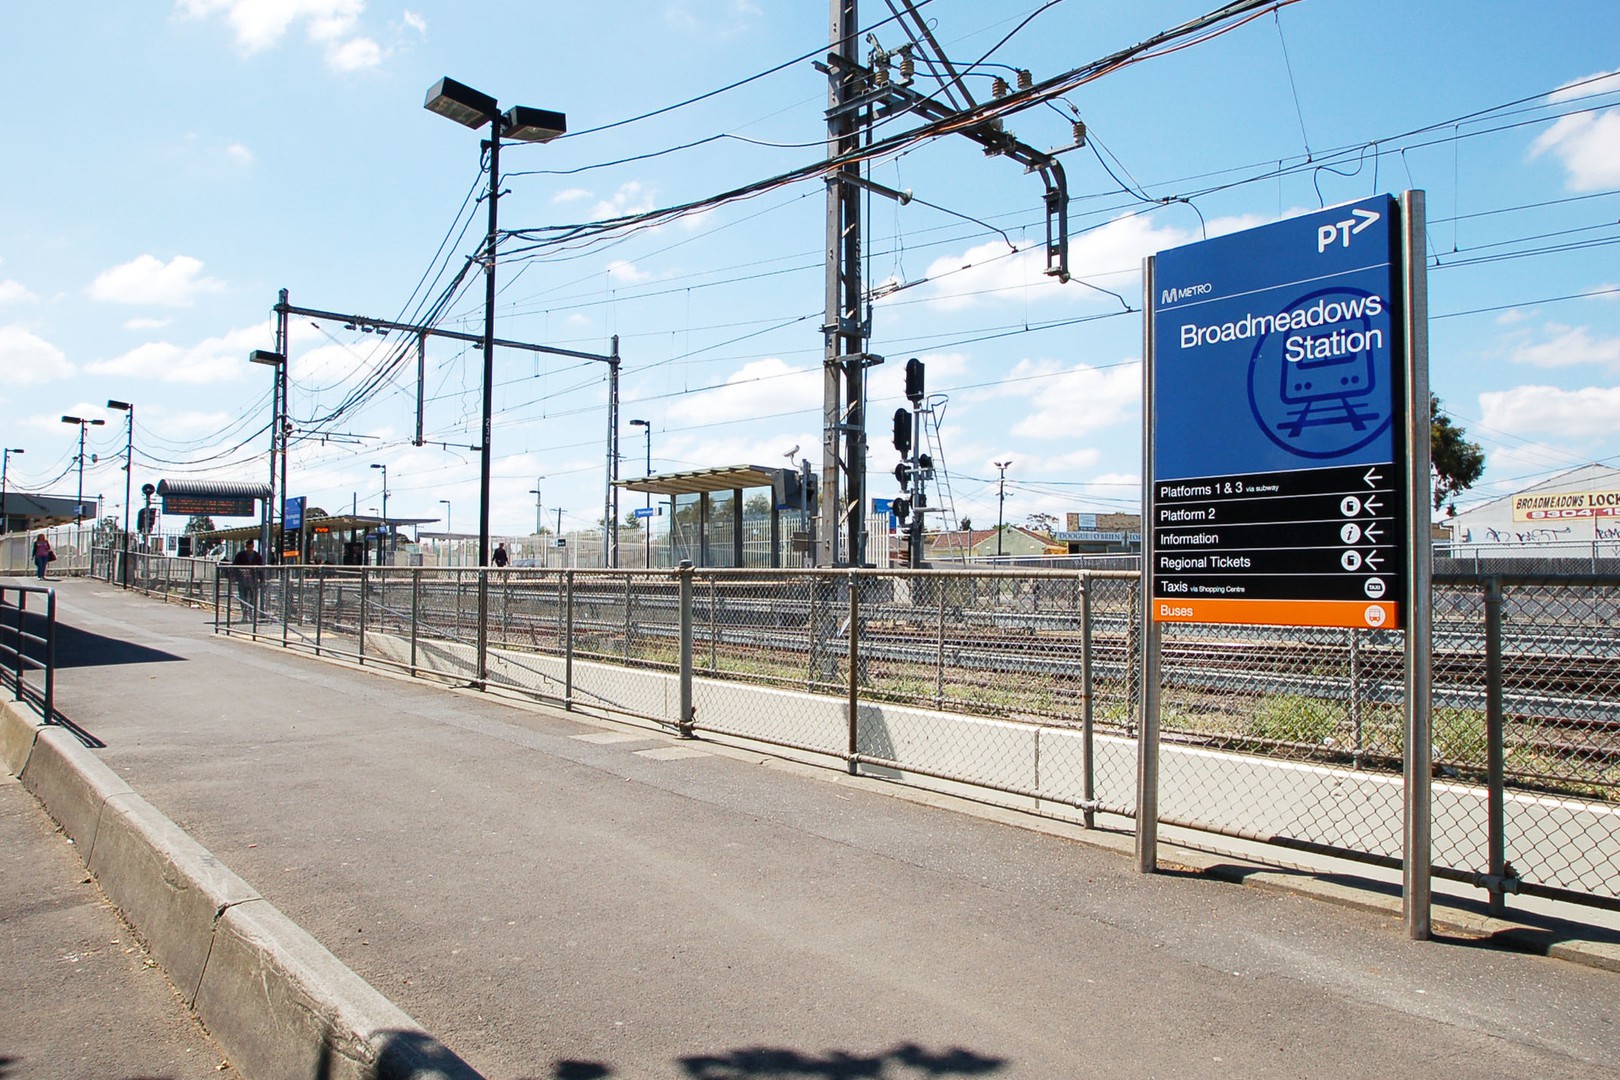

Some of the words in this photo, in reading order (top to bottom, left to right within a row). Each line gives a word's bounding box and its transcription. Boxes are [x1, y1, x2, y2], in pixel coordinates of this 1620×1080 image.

[1178, 283, 1212, 299] METRO
[1180, 295, 1382, 349] Broadmeadows
[1285, 329, 1382, 362] Station
[1160, 485, 1212, 498] Platforms
[1215, 483, 1220, 495] 1
[1223, 482, 1233, 494] &
[1235, 481, 1243, 493] 3
[1255, 484, 1280, 492] subway
[1516, 495, 1584, 510] BROADMEADOWS
[1160, 509, 1206, 521] Platform
[1208, 508, 1216, 519] 2
[1160, 532, 1219, 545] Information
[1160, 556, 1207, 571] Regional
[1210, 555, 1251, 568] Tickets
[1160, 581, 1189, 593] Taxis
[1199, 585, 1225, 594] Shopping
[1160, 604, 1194, 617] Buses
